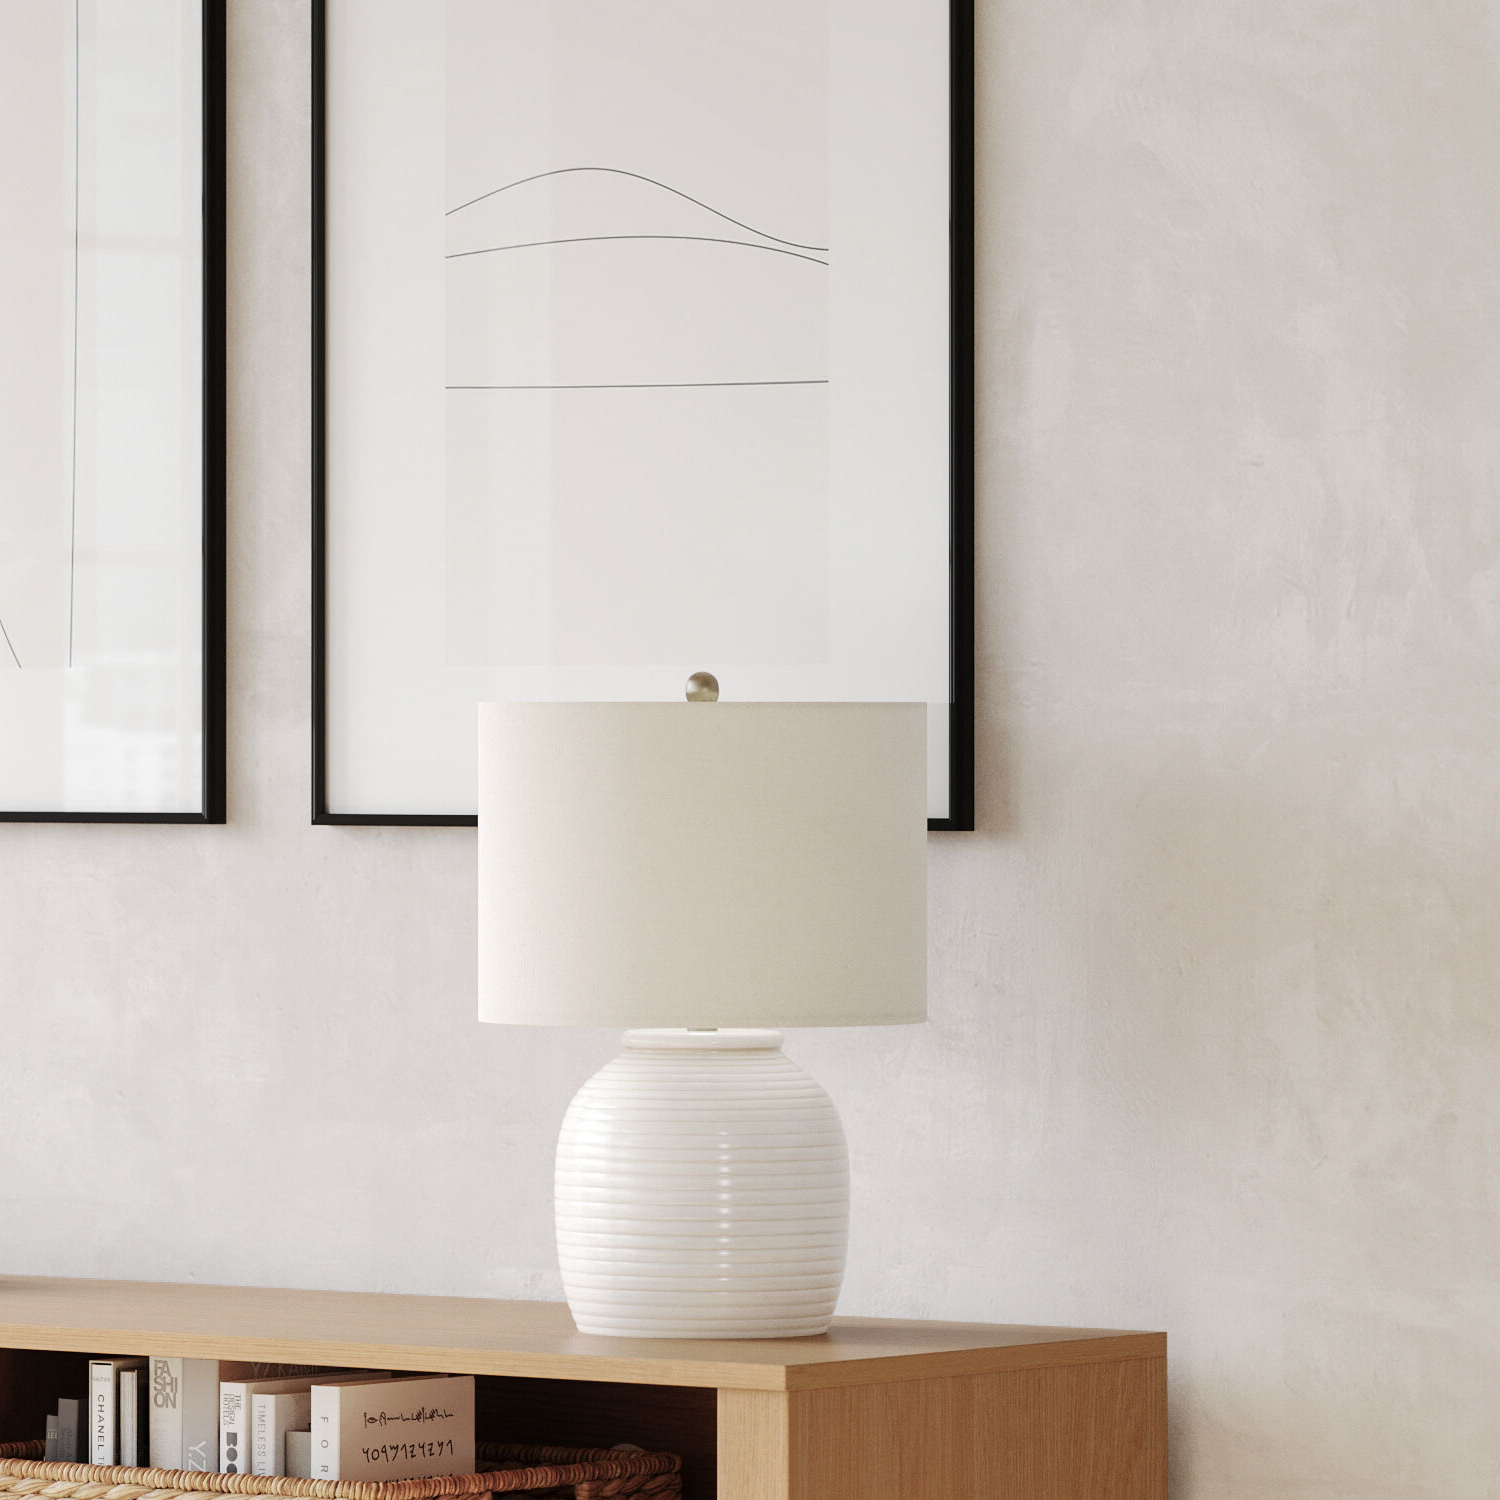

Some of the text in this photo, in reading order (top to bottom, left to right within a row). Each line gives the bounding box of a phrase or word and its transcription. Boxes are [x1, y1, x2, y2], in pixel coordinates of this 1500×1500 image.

[97, 1394, 105, 1451] CHANEL
[234, 1393, 242, 1410] THE
[257, 1404, 266, 1457] TIMELESS
